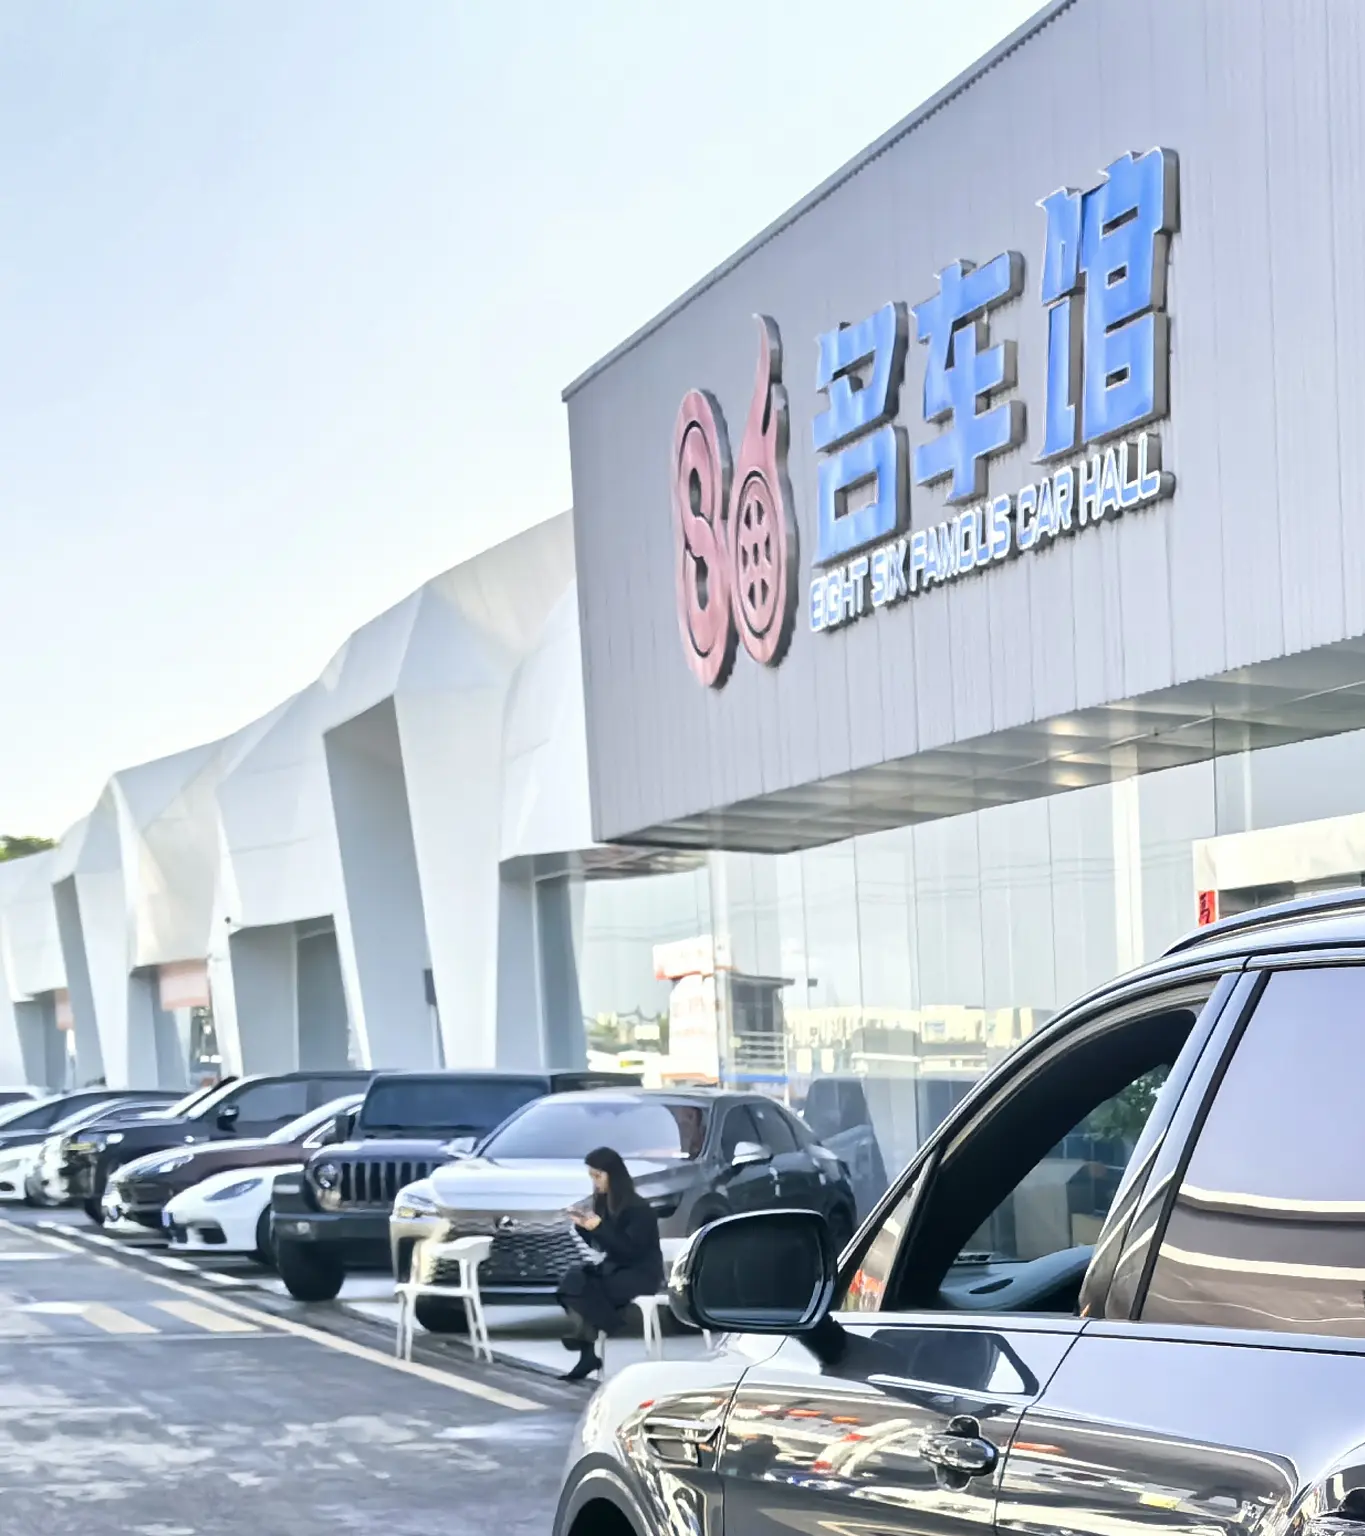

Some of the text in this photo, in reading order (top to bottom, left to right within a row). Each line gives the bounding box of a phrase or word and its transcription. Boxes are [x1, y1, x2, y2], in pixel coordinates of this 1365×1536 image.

[811, 146, 1174, 566] 名车馆
[809, 432, 1162, 632] EIGHT SIX FAMOUS CAR HALL
